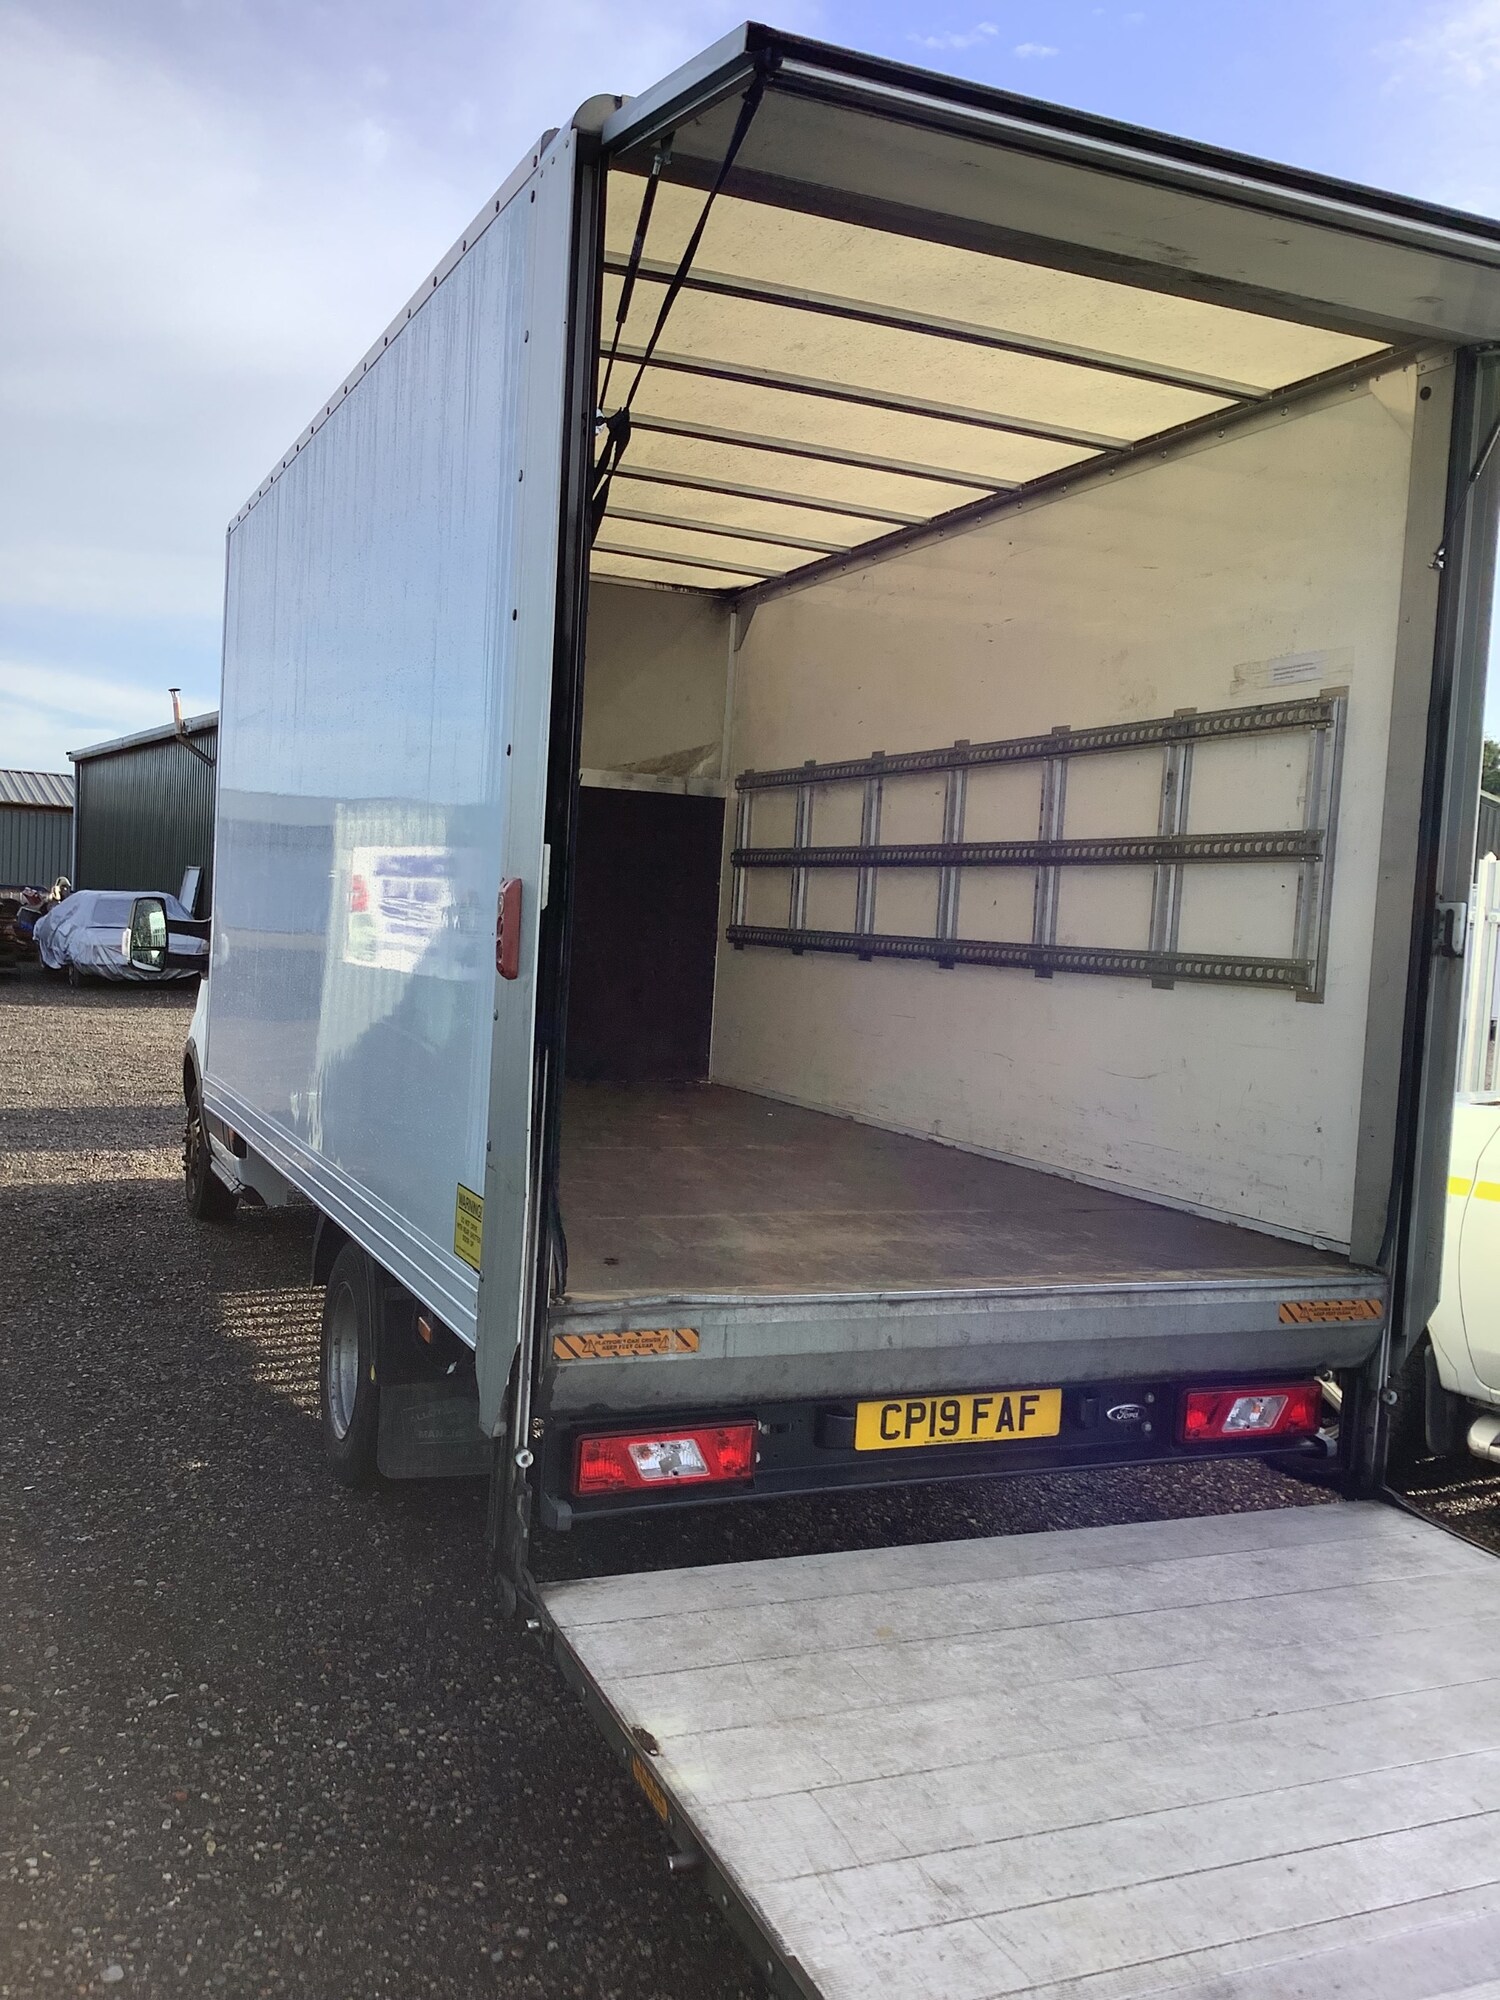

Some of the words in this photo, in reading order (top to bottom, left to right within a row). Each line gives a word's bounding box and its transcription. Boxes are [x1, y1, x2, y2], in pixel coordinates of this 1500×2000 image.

[880, 1400, 960, 1441] CP19
[971, 1395, 1040, 1434] FAF
[1116, 1407, 1140, 1420] Ford
